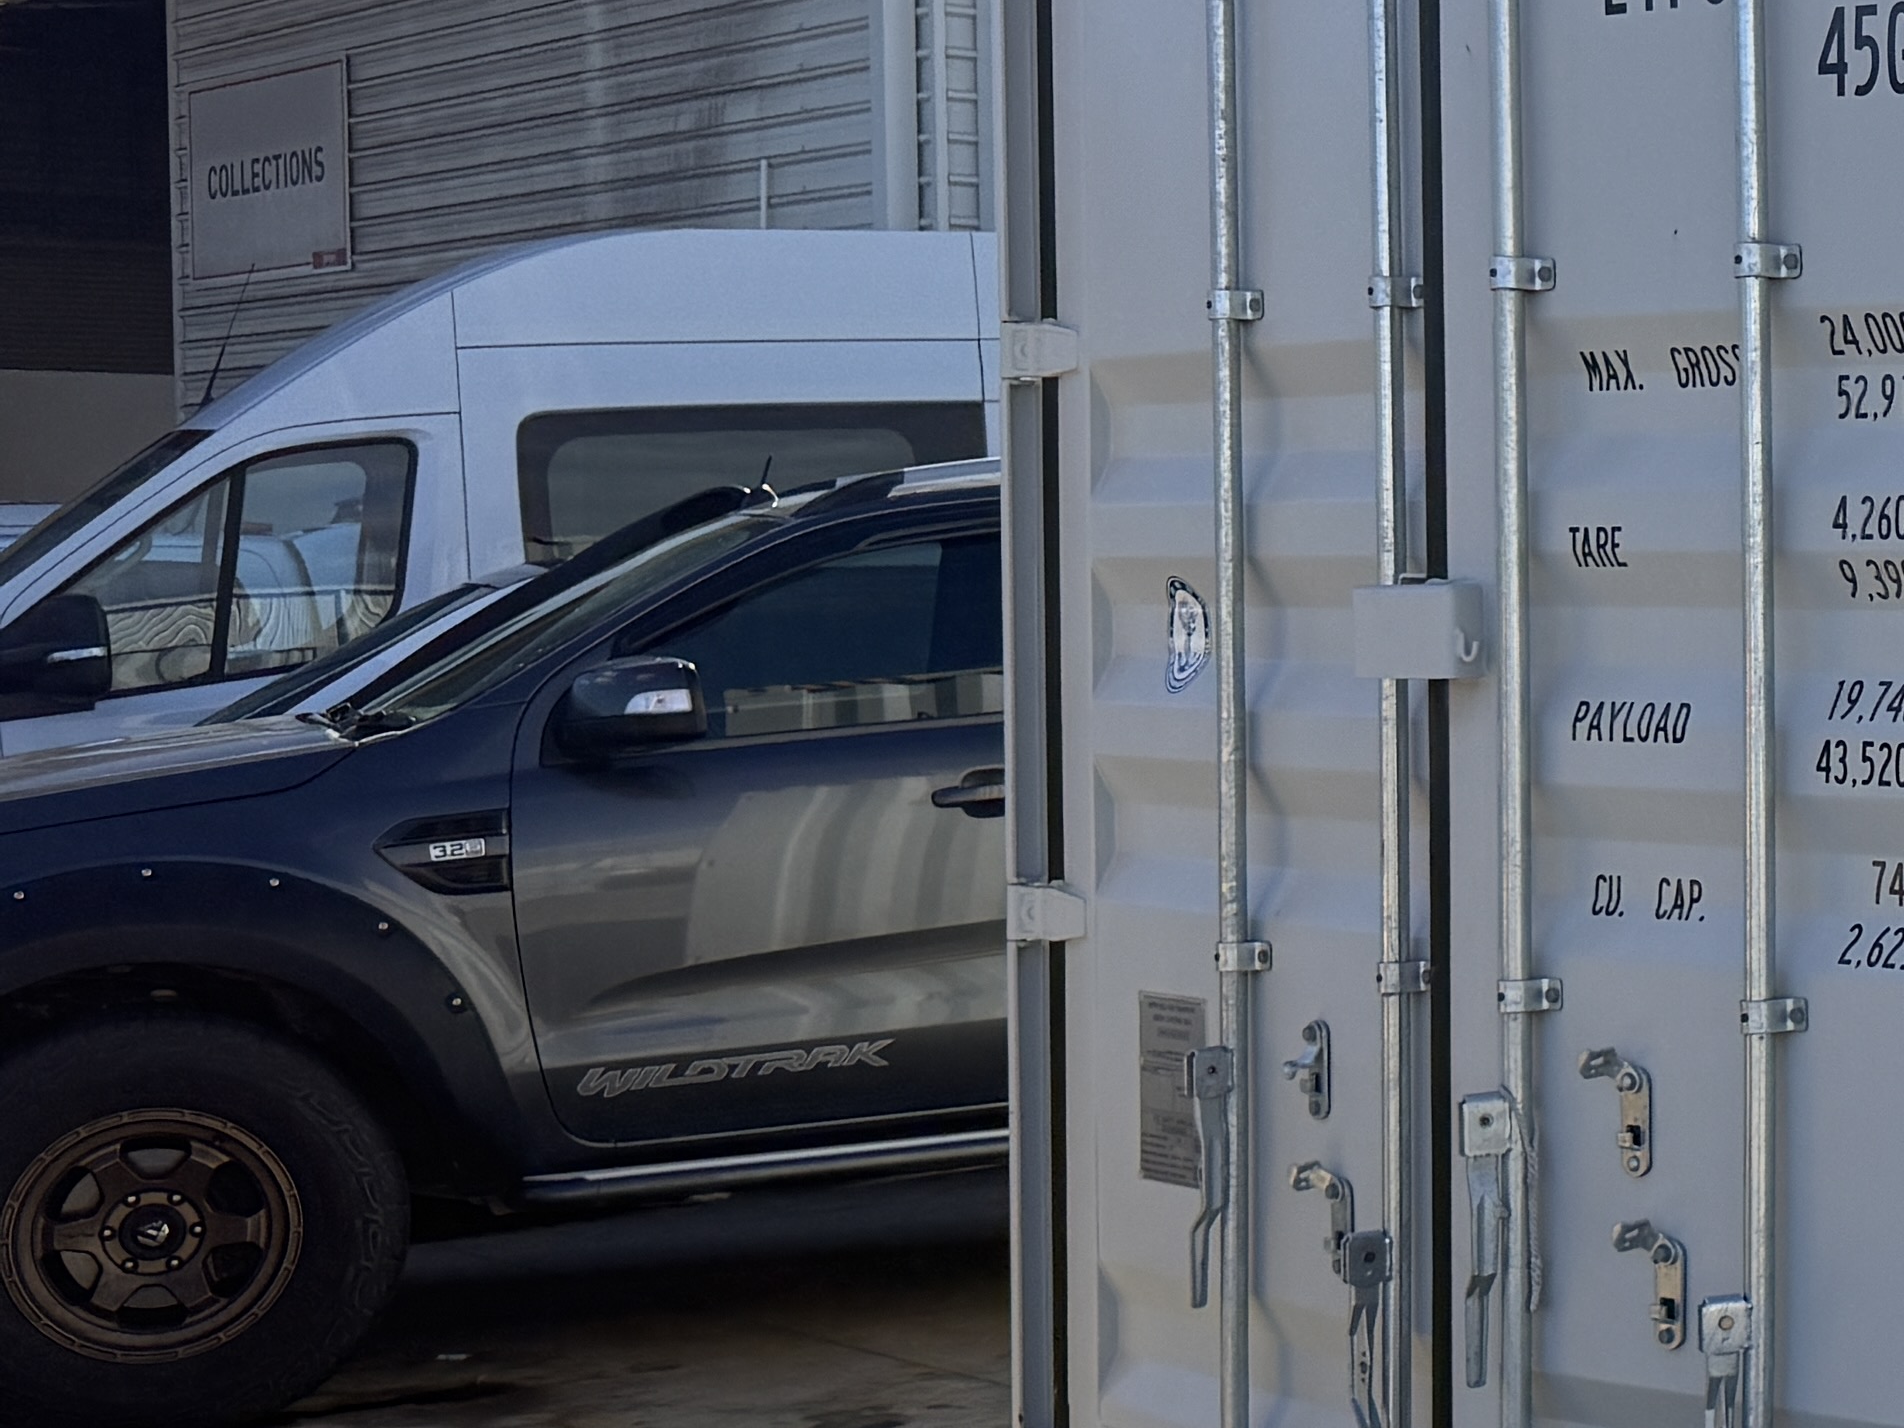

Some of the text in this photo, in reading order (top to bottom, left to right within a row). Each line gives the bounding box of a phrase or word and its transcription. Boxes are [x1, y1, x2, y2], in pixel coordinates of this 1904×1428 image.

[207, 145, 326, 200] COLLECTIONS
[1579, 349, 1644, 392] MAX.
[1669, 343, 1740, 389] GROS
[1568, 526, 1629, 568] TARE
[1572, 700, 1692, 744] PAYLOAD
[1591, 874, 1624, 918] CU.
[1654, 877, 1705, 922] CAP.
[576, 1038, 896, 1098] WILDTRAK
